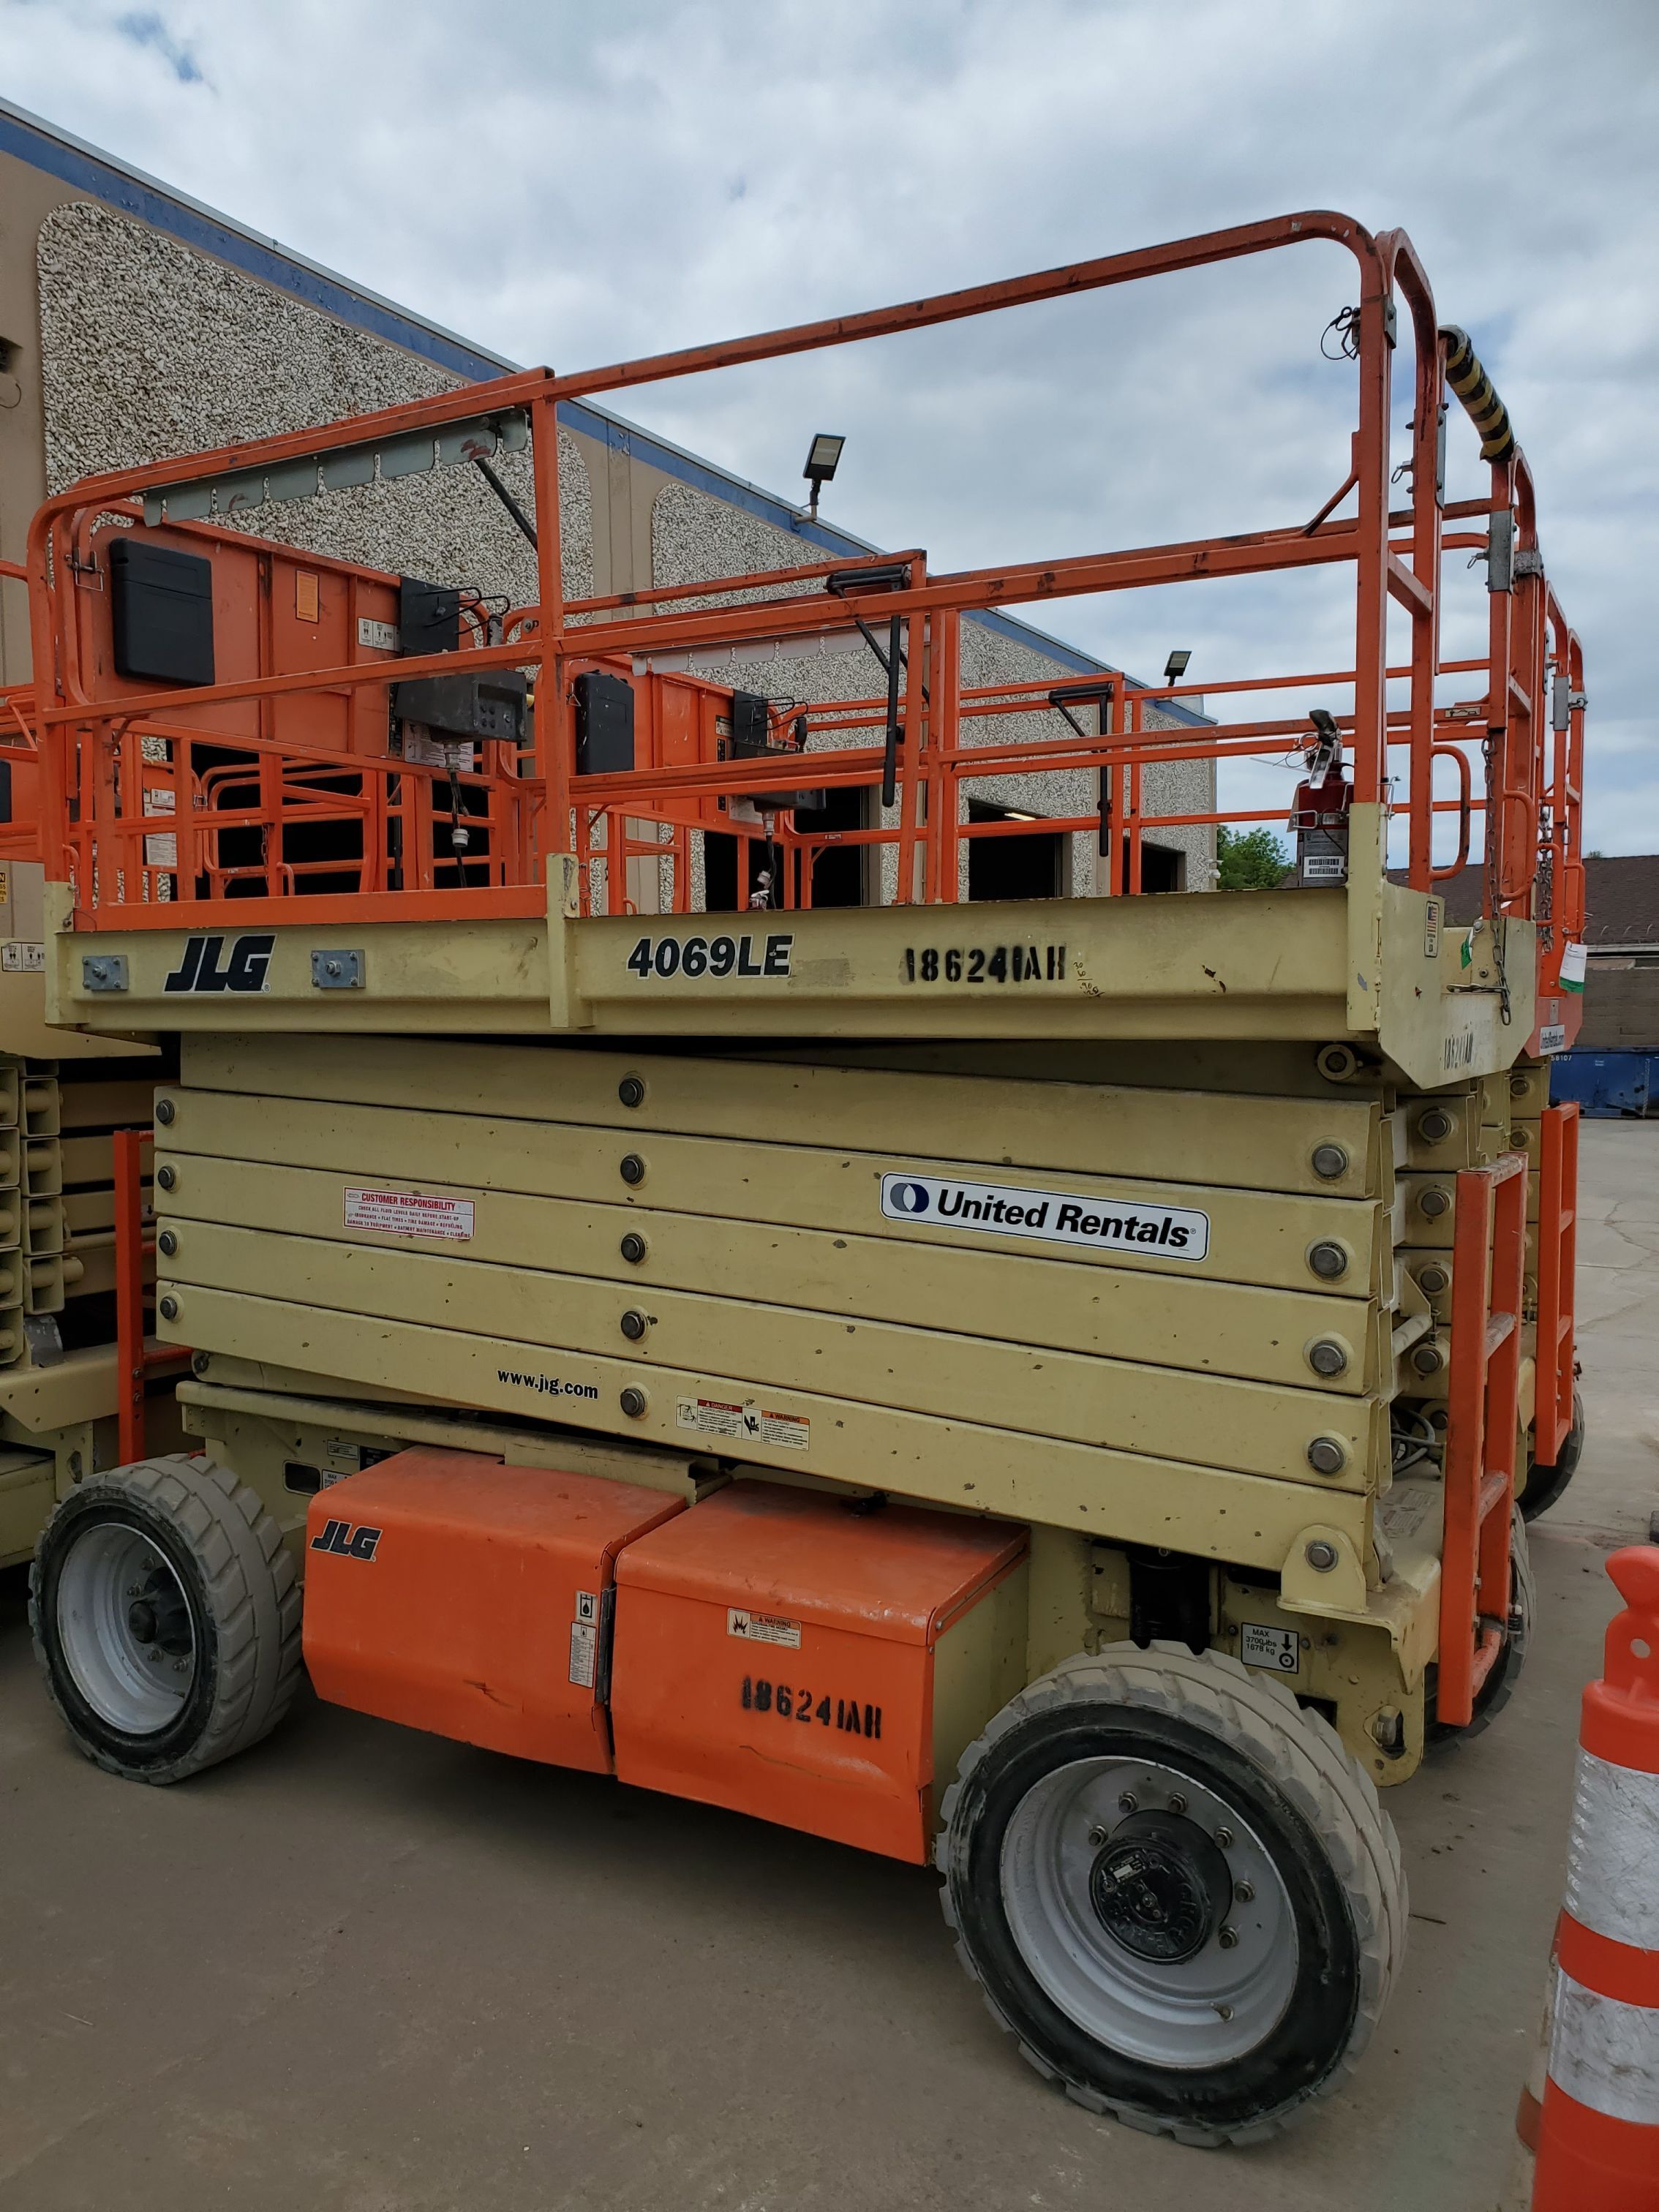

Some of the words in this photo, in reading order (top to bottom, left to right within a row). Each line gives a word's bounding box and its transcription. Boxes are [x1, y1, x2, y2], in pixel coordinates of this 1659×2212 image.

[164, 935, 276, 992] JLG
[627, 935, 793, 978] 4069LE
[361, 1193, 398, 1205] CUSTOMER
[400, 1196, 456, 1211] RESPONSIBILITY
[937, 1188, 1049, 1229] United
[497, 1369, 598, 1399] www.jlg.com
[711, 1402, 732, 1411] DANGER
[775, 1413, 800, 1423] WARNING
[311, 1521, 382, 1560] JLG
[764, 1617, 791, 1628] WARNING
[1252, 1628, 1270, 1637] MAX
[1246, 1636, 1263, 1644] 3700
[1264, 1639, 1277, 1647] lbs
[1246, 1643, 1263, 1652] 1678
[1266, 1647, 1275, 1655] kg
